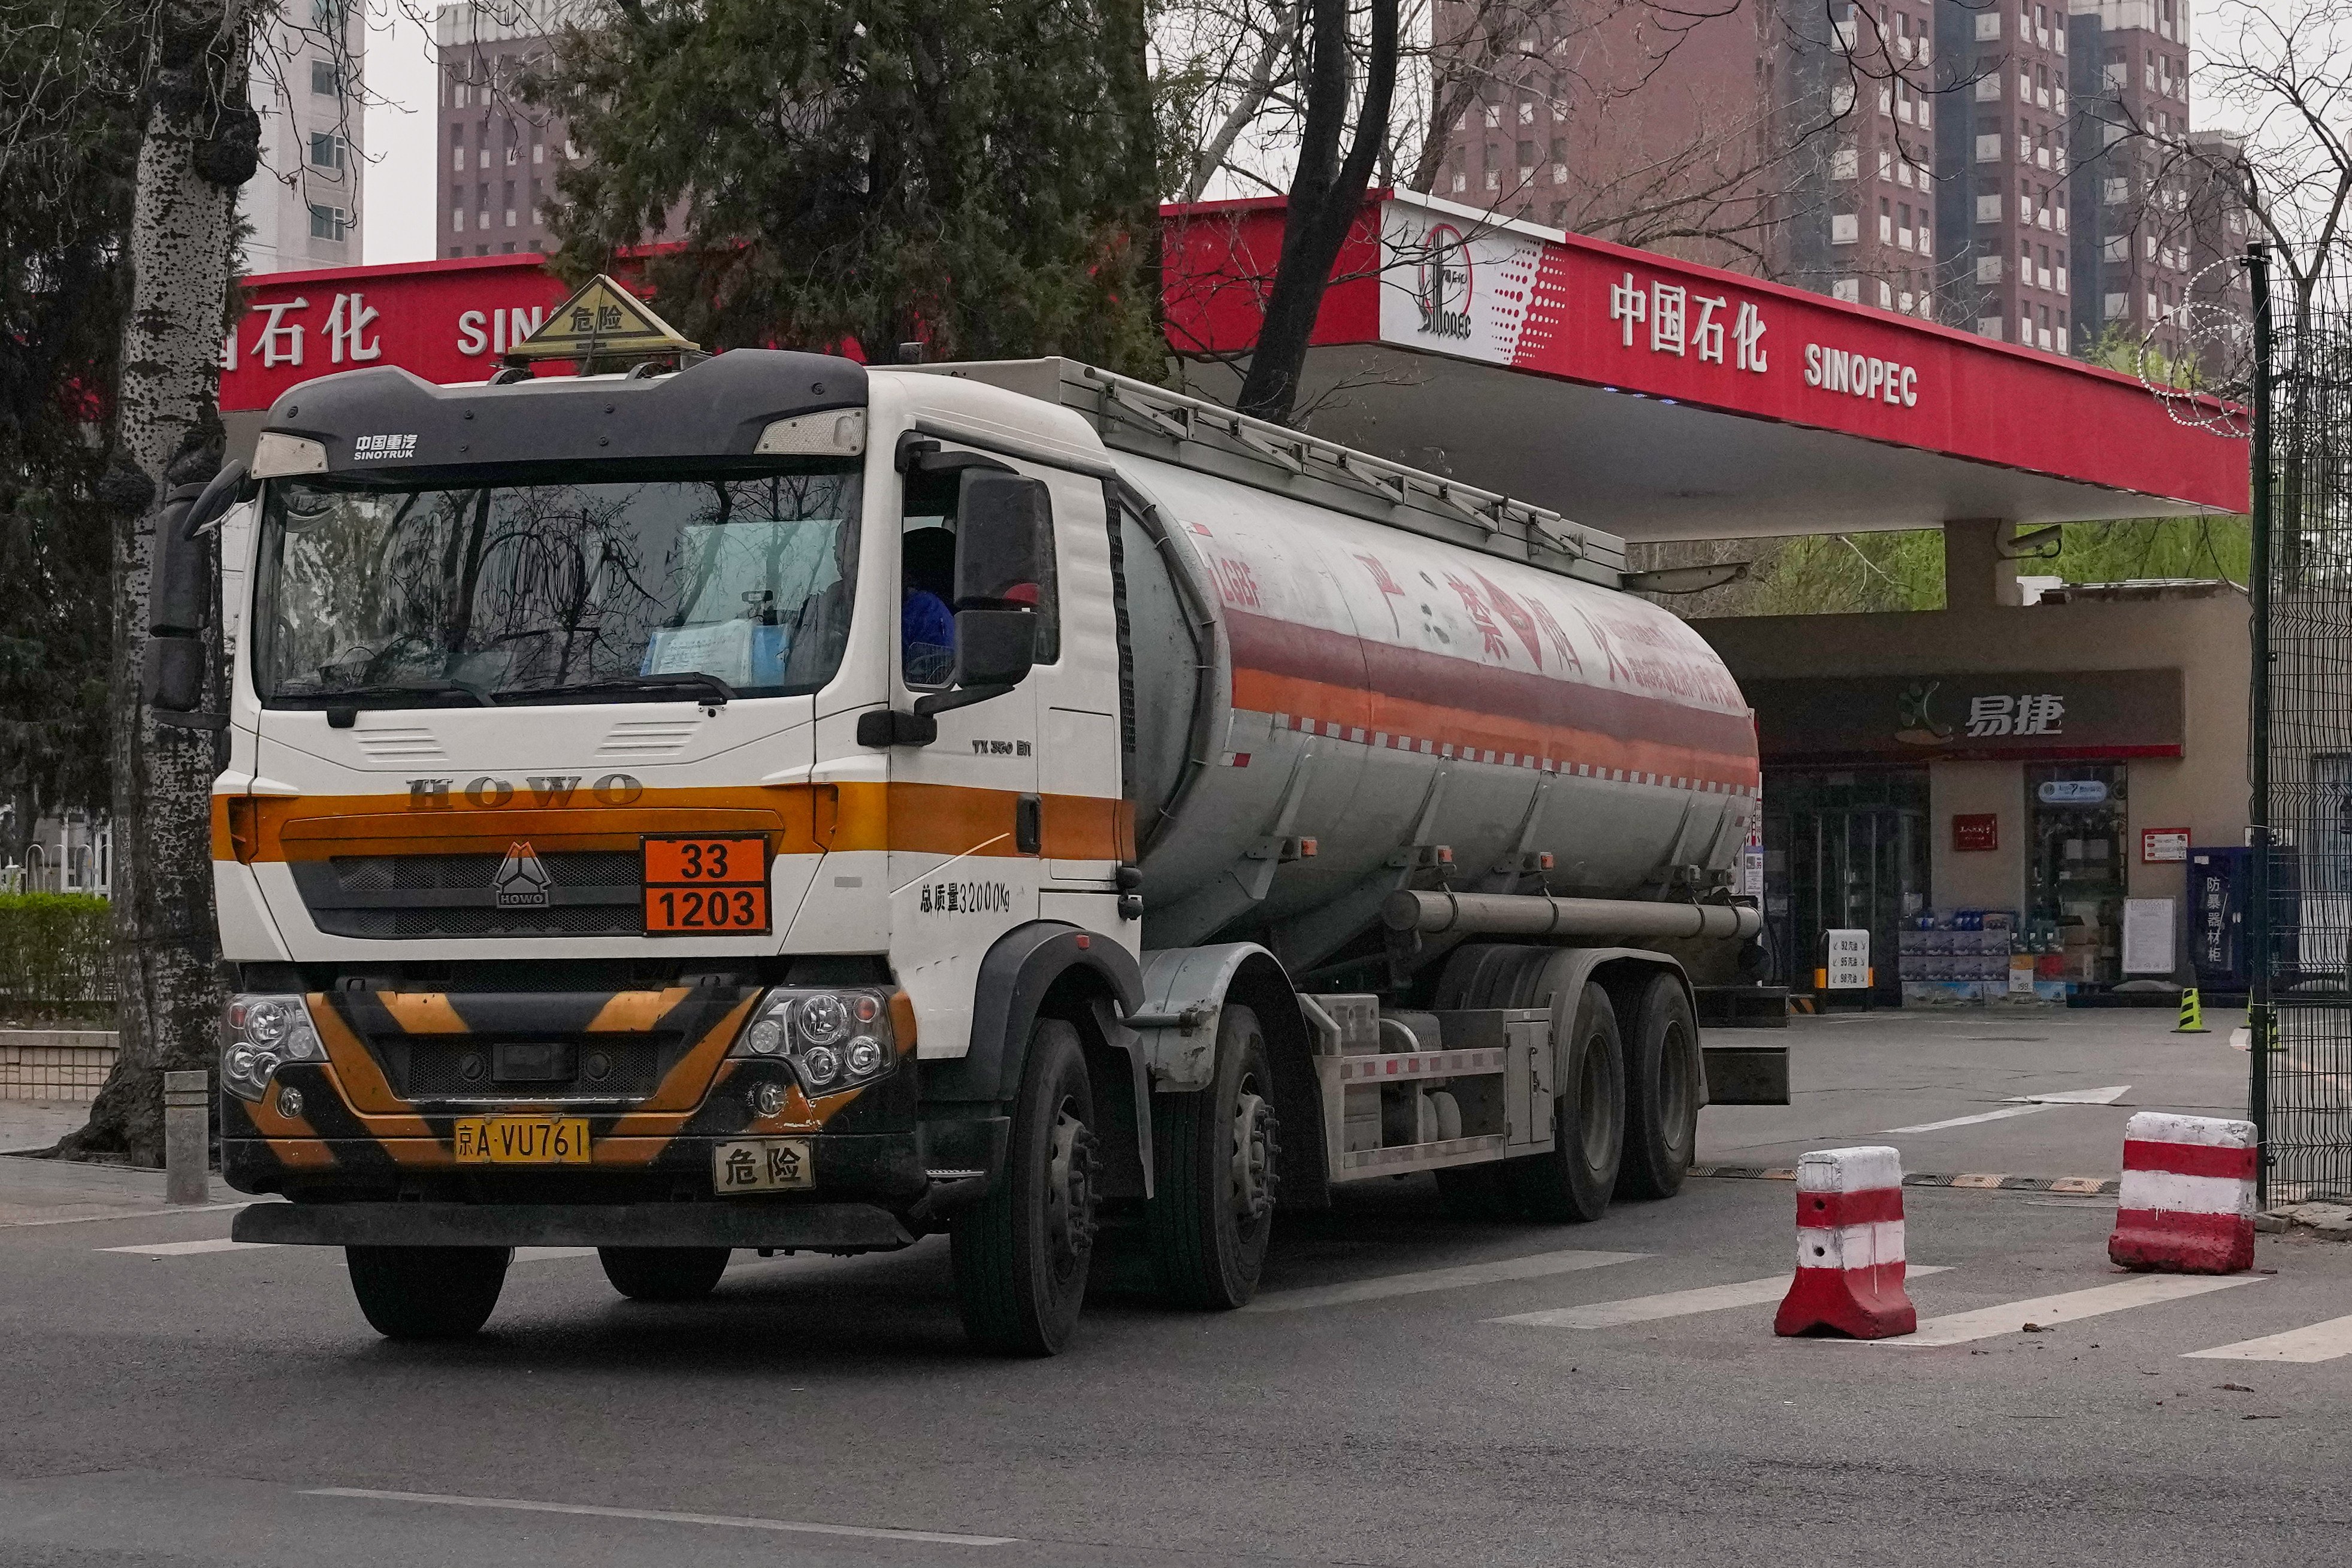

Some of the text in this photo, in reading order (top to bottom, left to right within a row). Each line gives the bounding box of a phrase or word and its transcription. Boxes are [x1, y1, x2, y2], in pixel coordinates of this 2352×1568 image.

[457, 306, 562, 356] SIN
[571, 305, 623, 332] 危险
[1610, 273, 1917, 407] 中国石化 SINOPEC
[354, 449, 414, 460] SINOTRUK
[356, 434, 418, 451] 中国重汽
[1965, 694, 2065, 737] 易捷
[972, 740, 988, 754] TX
[406, 773, 643, 810] HOWO
[681, 843, 728, 879] 33
[501, 894, 543, 904] HOWO
[660, 891, 755, 927] 1203
[2207, 877, 2222, 962] 防暴器材柜
[725, 1147, 802, 1186] 危险
